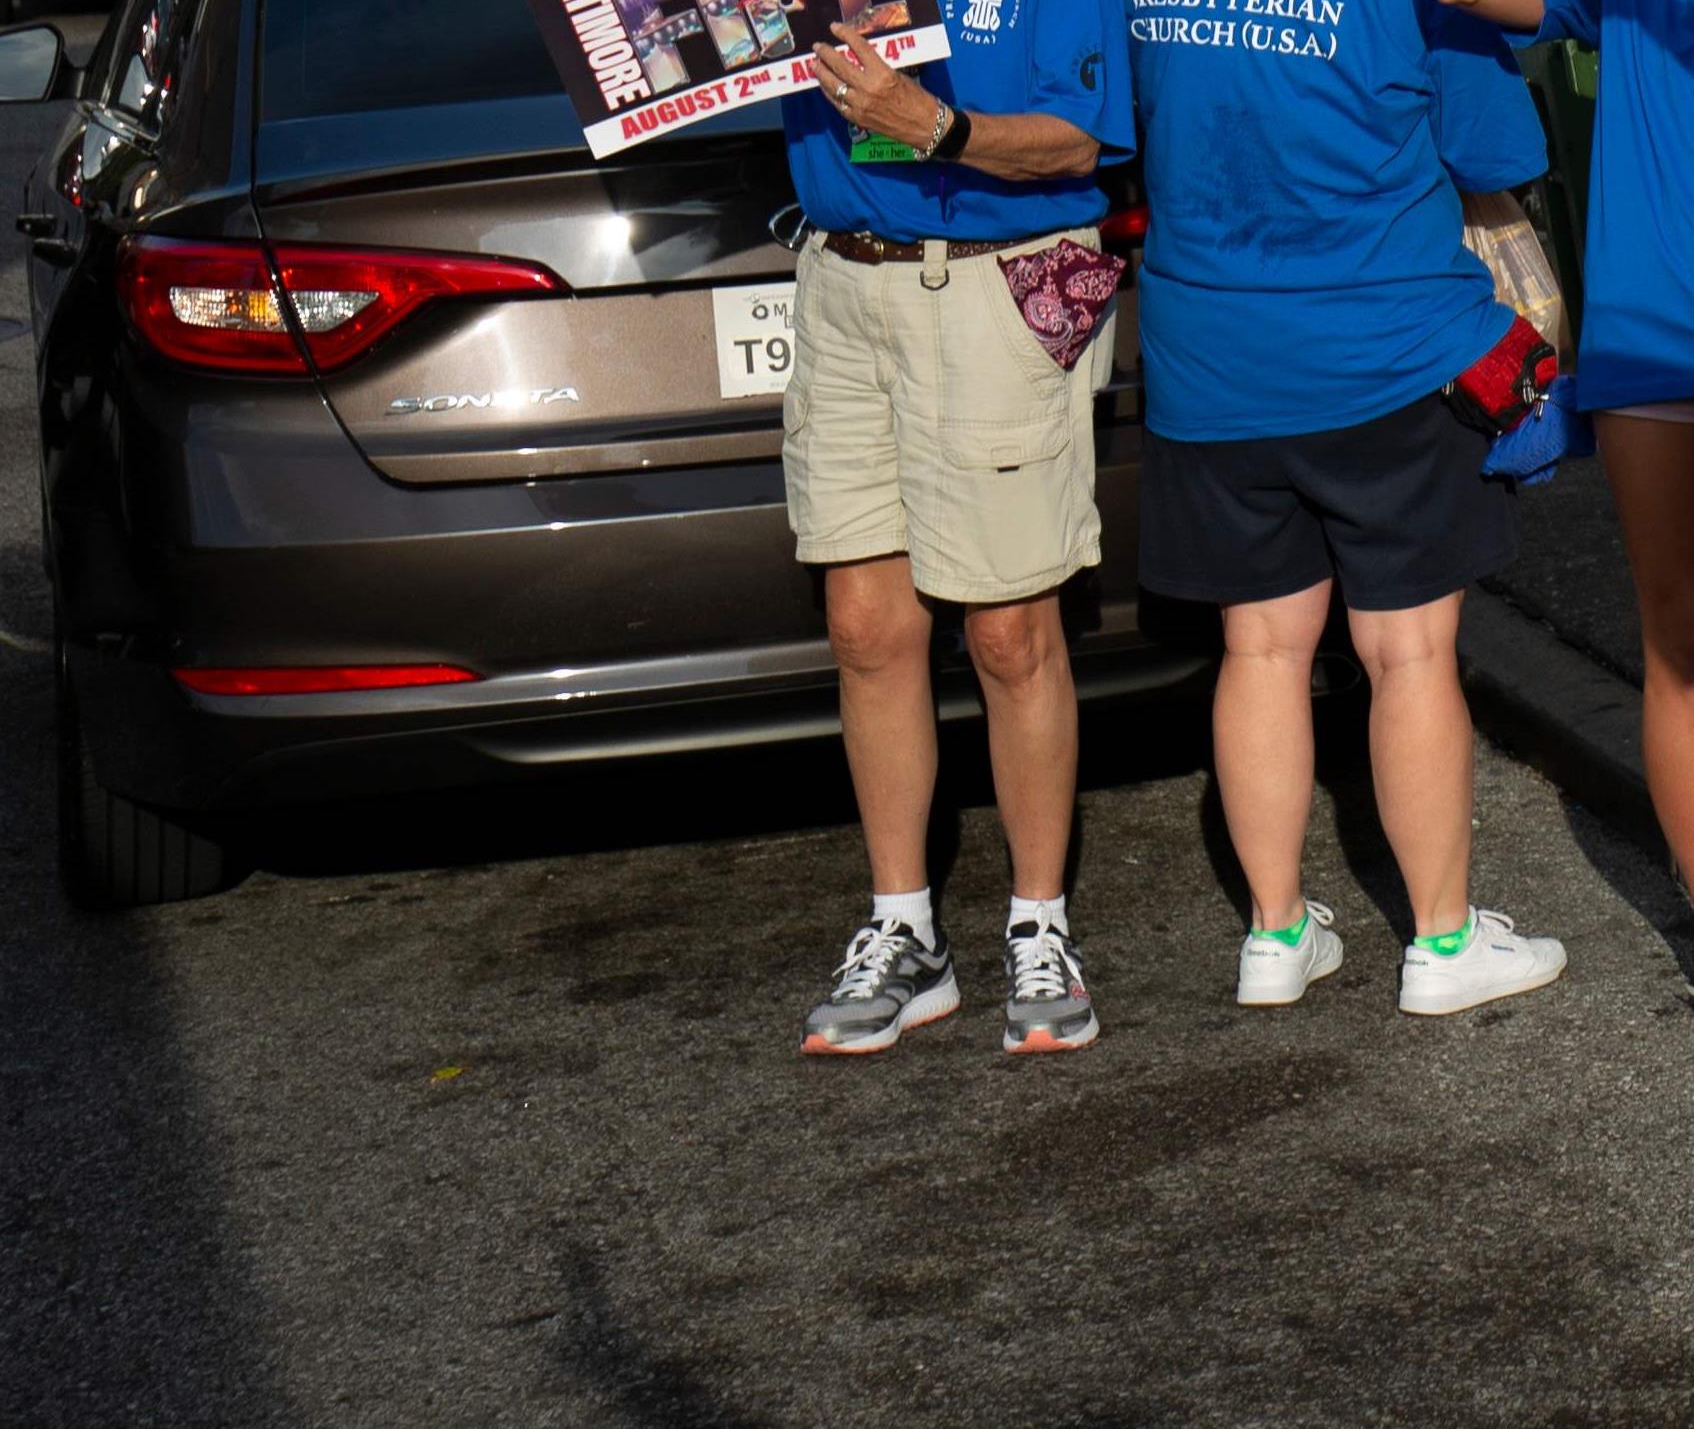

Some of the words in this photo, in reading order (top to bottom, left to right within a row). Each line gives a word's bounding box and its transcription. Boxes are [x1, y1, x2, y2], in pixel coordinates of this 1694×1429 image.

[960, 30, 996, 44] (USA)
[1130, 17, 1236, 47] CHURCH
[1242, 19, 1338, 61] (U.S.A.)
[620, 84, 729, 139] AUGUST
[734, 71, 771, 95] 2nd
[885, 34, 915, 61] 4TH
[385, 386, 581, 416] SONATA
